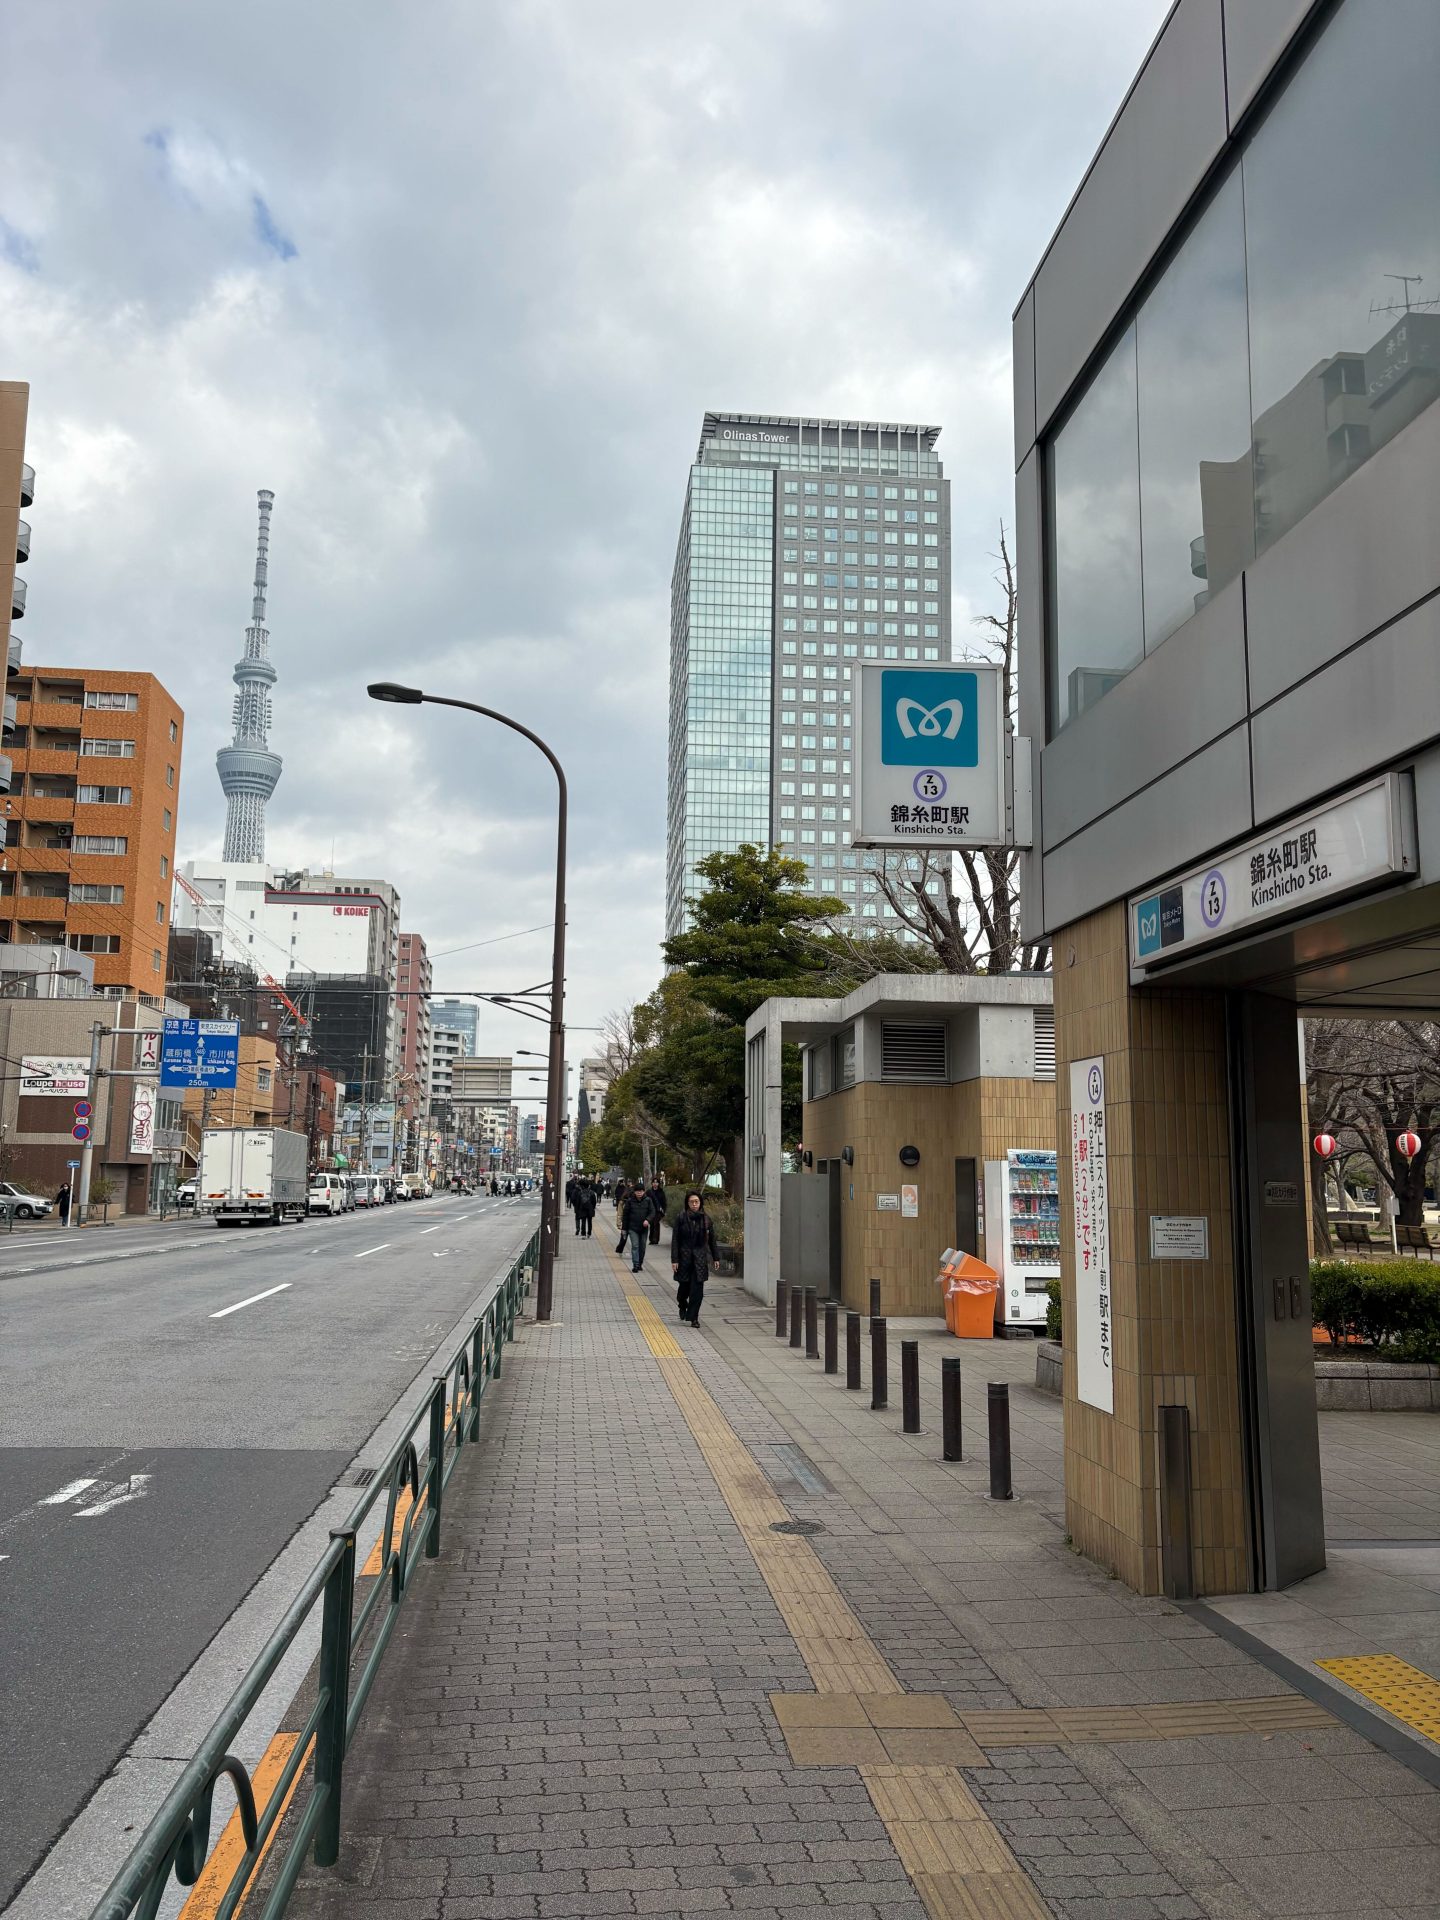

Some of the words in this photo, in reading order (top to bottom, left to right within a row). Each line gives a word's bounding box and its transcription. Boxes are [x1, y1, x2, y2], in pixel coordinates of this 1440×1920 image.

[723, 430, 758, 441] Olinas
[759, 431, 790, 442] Tower
[926, 775, 934, 784] Z
[923, 785, 938, 796] 13
[890, 804, 969, 824] 錦糸町駅
[894, 824, 944, 834] Kinshicho
[947, 825, 966, 835] Sta.
[1250, 829, 1318, 887] 錦糸町駅
[1210, 881, 1217, 896] Z
[1251, 874, 1305, 908] Kinshicho
[1308, 865, 1332, 886] Sta.
[344, 907, 369, 916] KOIKE
[1208, 898, 1221, 916] 13
[182, 1020, 196, 1030] 押上
[165, 1048, 192, 1058] 蔵前橋
[209, 1049, 235, 1059] 市川橋
[24, 1079, 54, 1089] Loupe
[55, 1079, 85, 1088] house
[1091, 1084, 1099, 1096] 14
